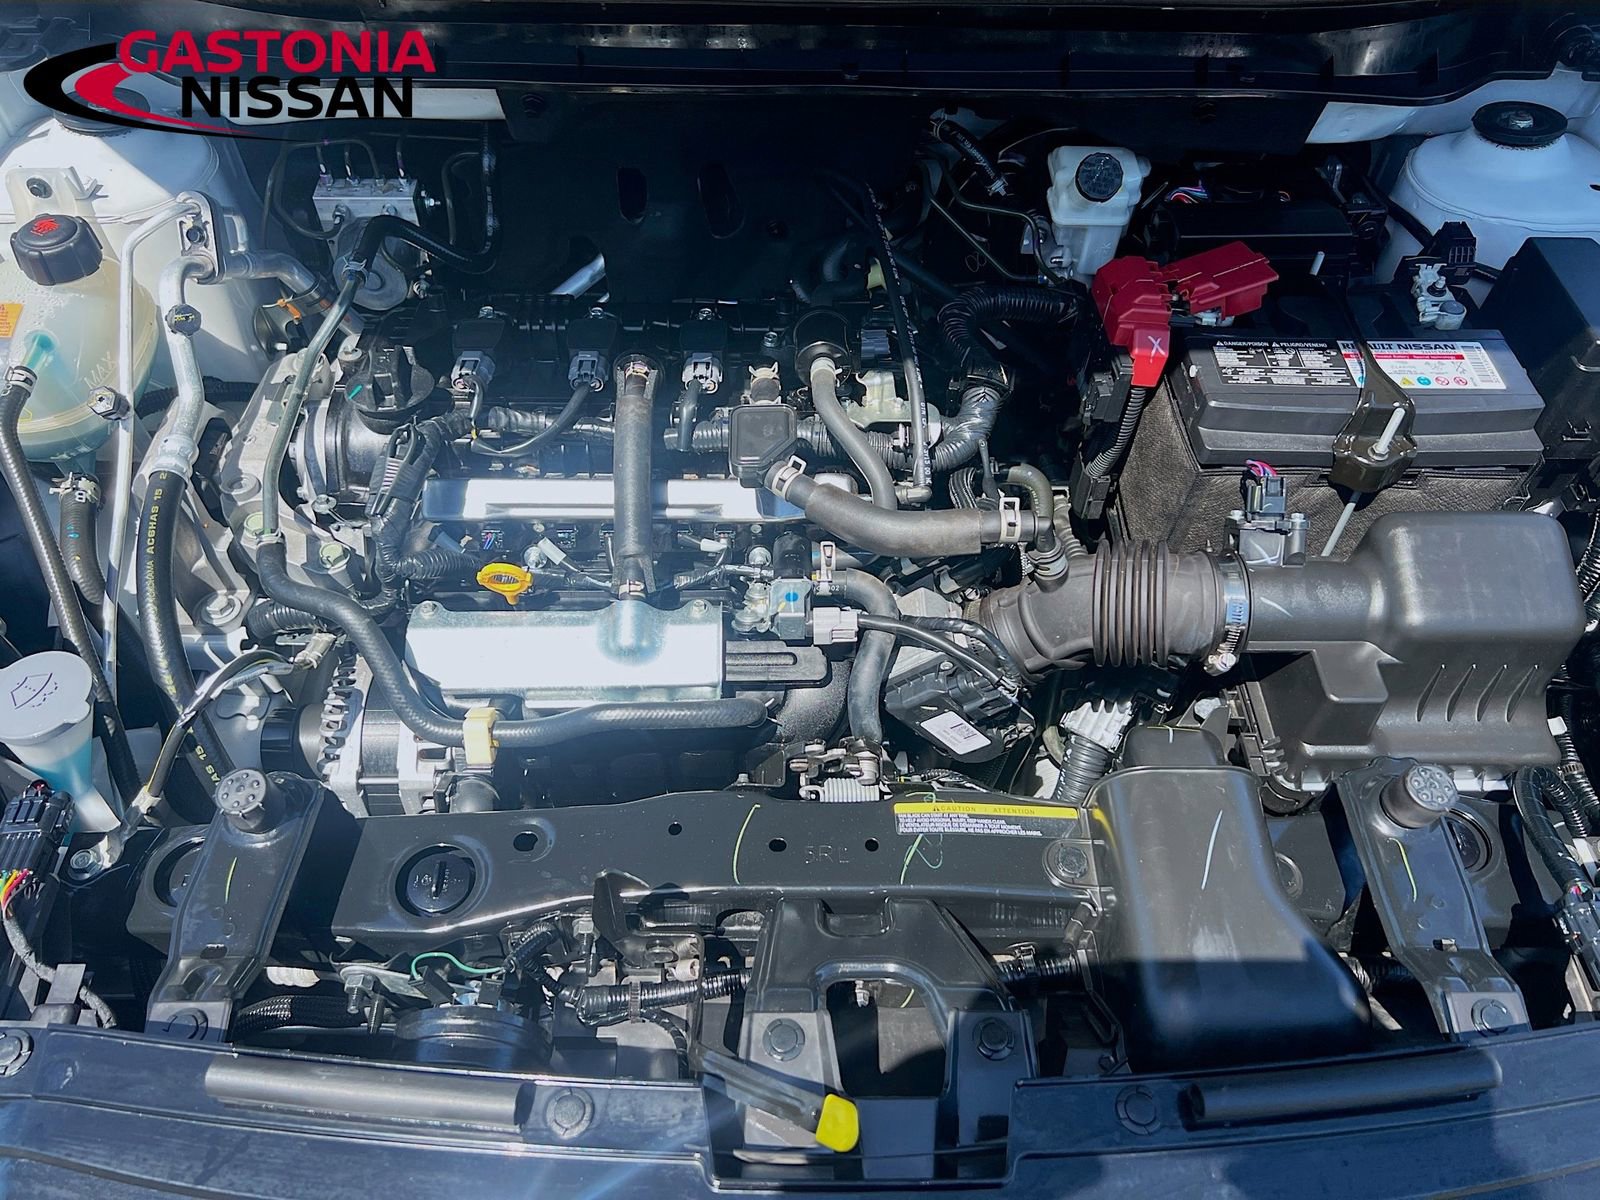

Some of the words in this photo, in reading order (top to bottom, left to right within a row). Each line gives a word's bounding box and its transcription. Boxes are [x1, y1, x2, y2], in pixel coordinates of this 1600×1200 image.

[1396, 343, 1457, 351] NISSAN
[154, 487, 163, 501] 15
[993, 807, 1035, 815] ATTENTION
